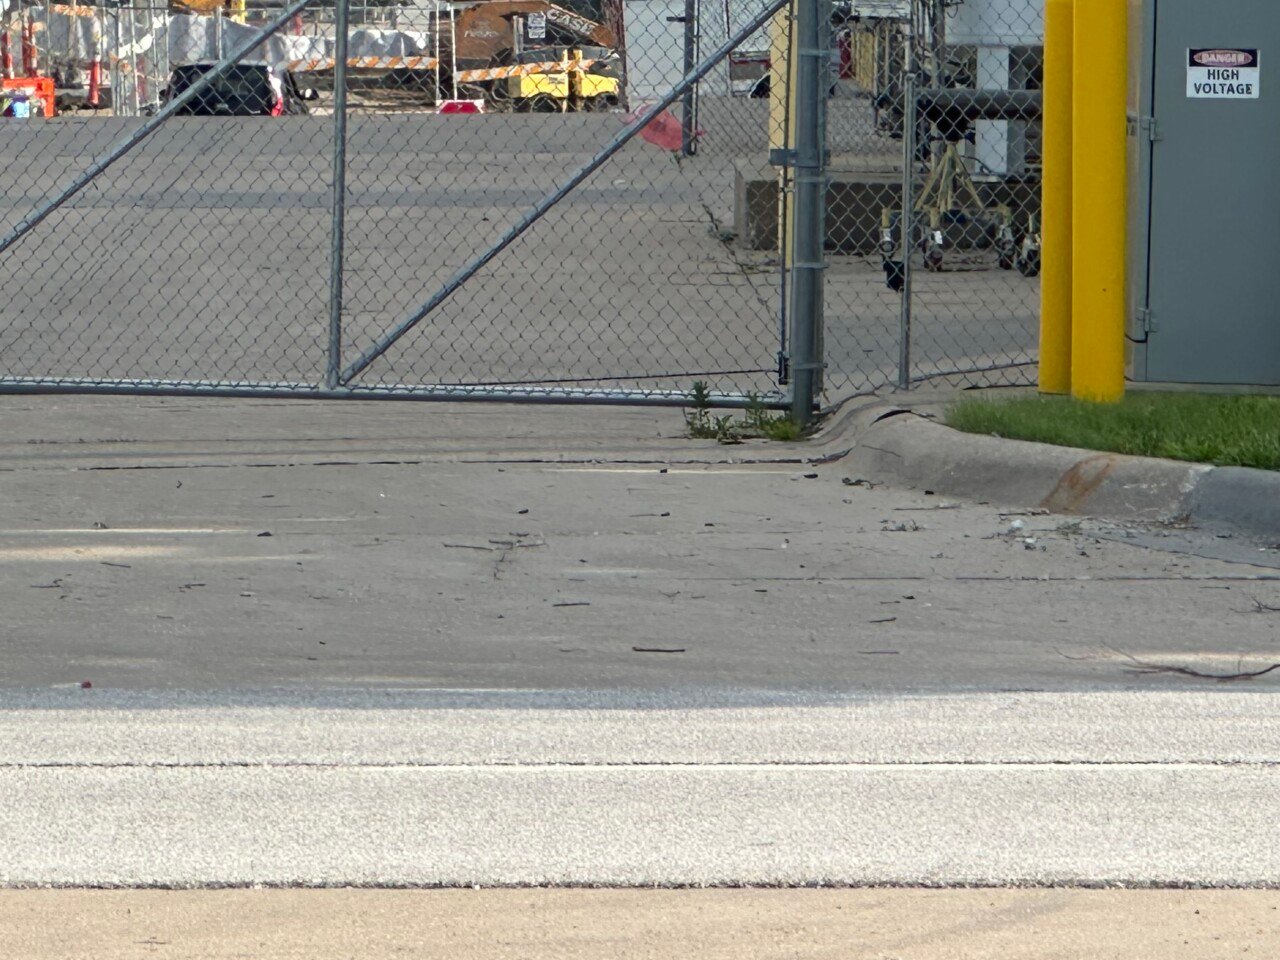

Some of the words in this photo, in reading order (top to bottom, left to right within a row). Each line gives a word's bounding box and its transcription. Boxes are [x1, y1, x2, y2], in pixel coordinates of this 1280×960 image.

[546, 8, 596, 36] CASE
[1207, 69, 1240, 81] HIGH
[1194, 83, 1253, 95] VOLTAGE
